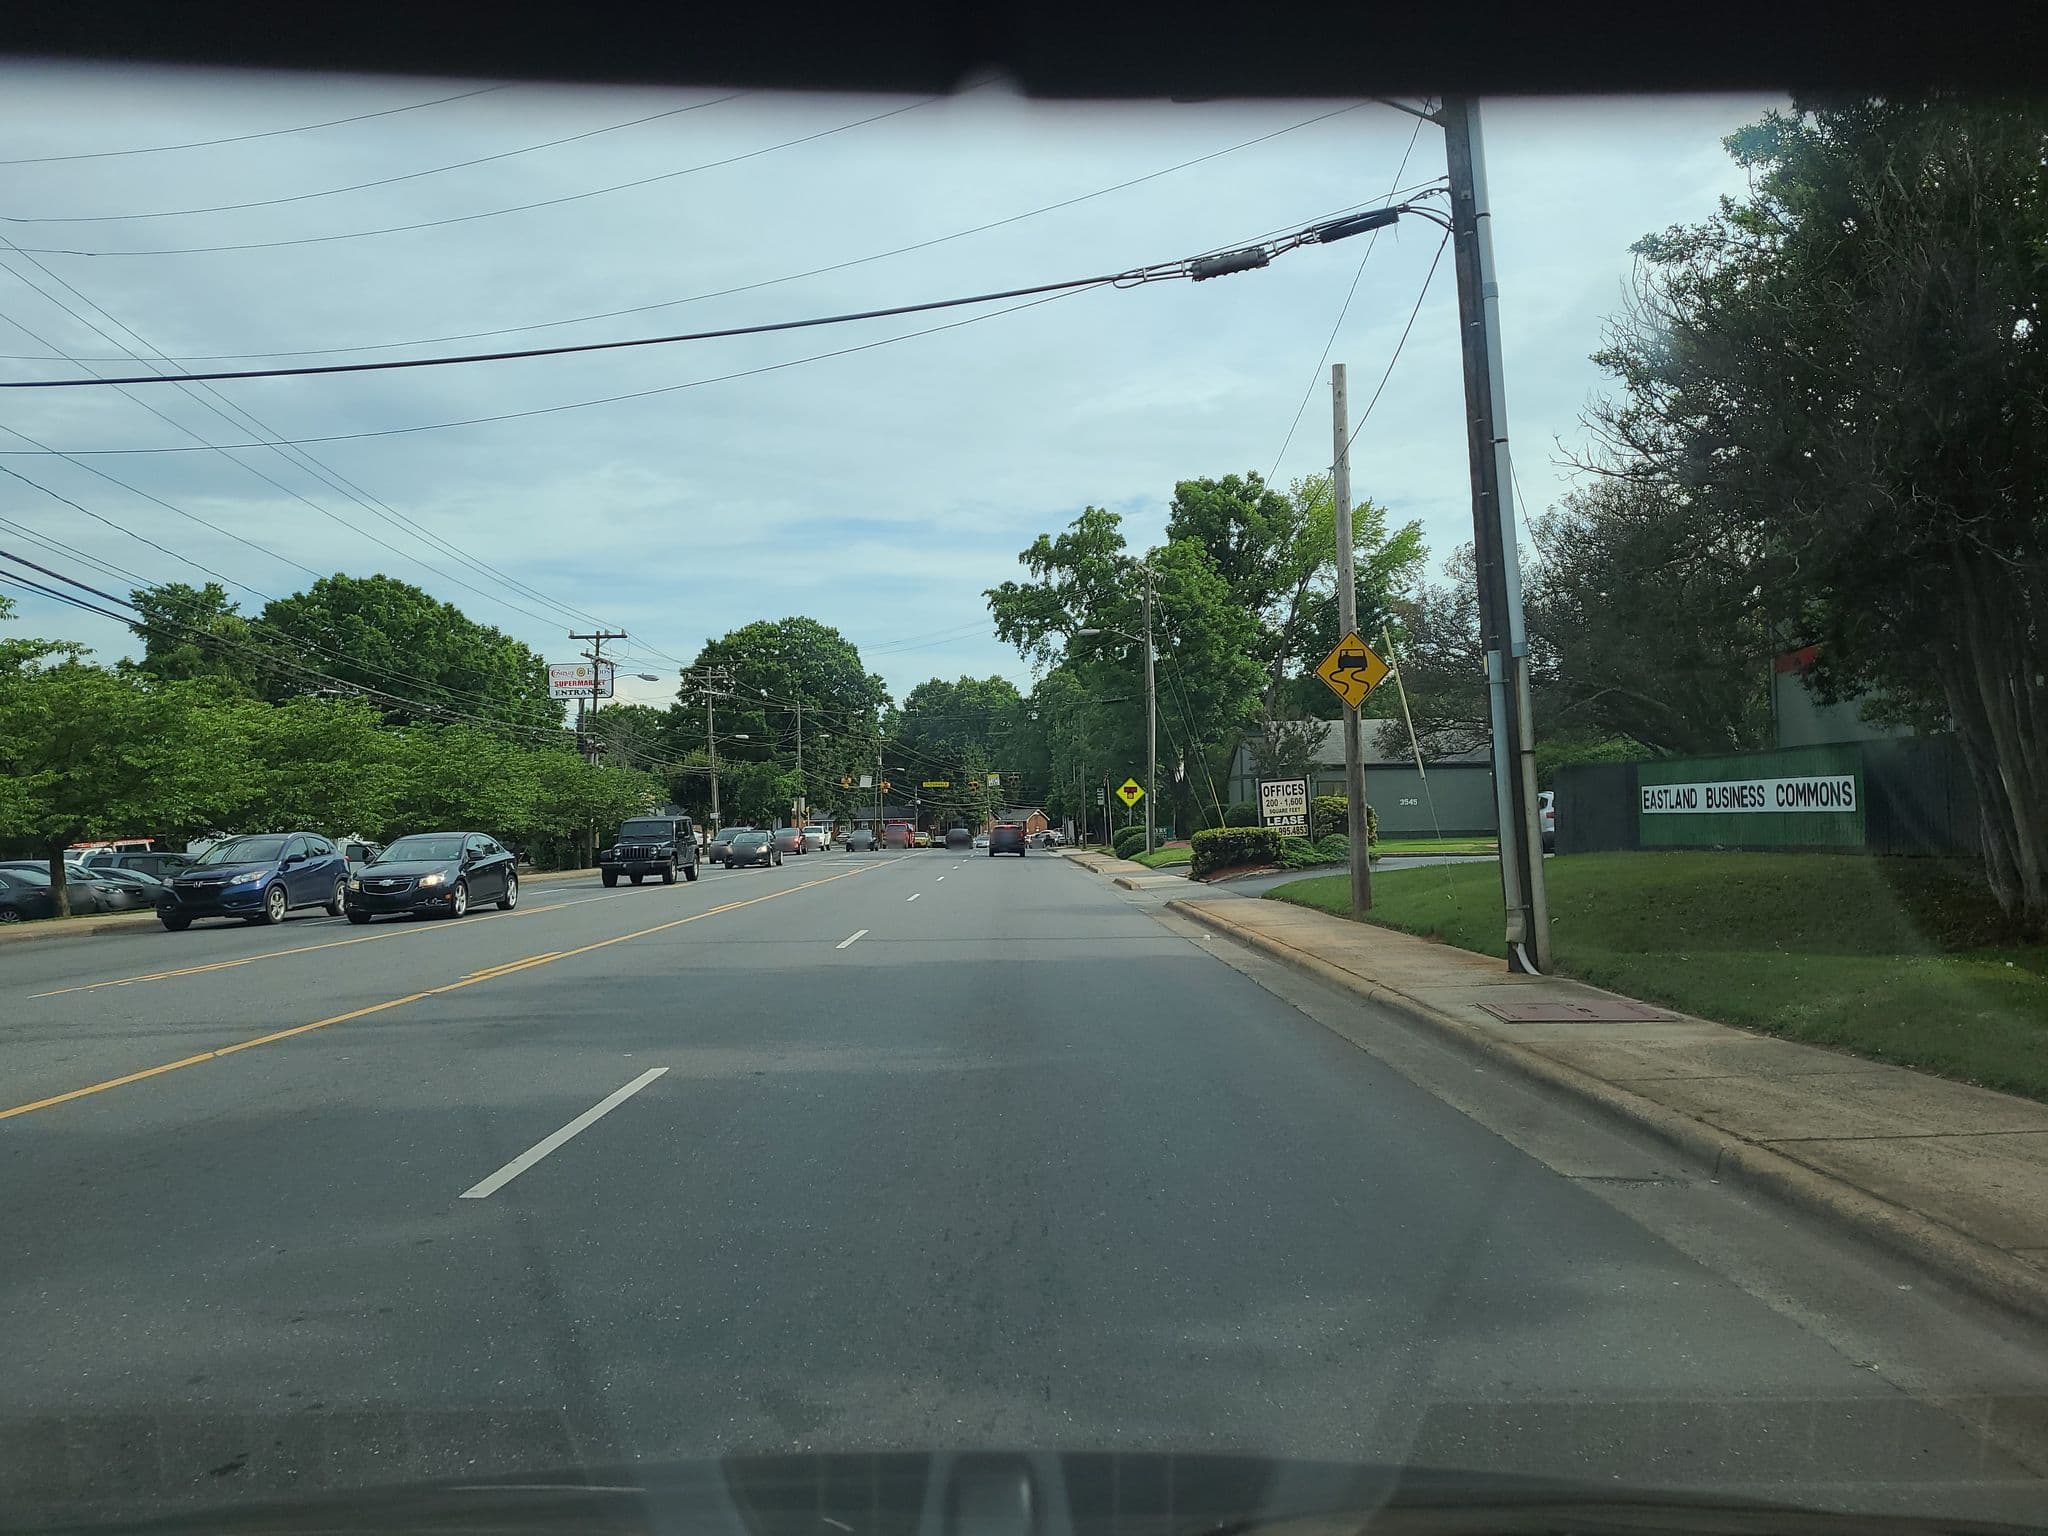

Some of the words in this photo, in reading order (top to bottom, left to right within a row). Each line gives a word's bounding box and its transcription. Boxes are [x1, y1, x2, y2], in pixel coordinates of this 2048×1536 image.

[1263, 784, 1304, 797] OFFICES
[1643, 787, 1698, 810] EASTLAND
[1705, 784, 1766, 809] BUSINESS
[1775, 780, 1853, 808] COMMONS
[1266, 799, 1279, 807] 200
[1267, 816, 1304, 826] LEASE
